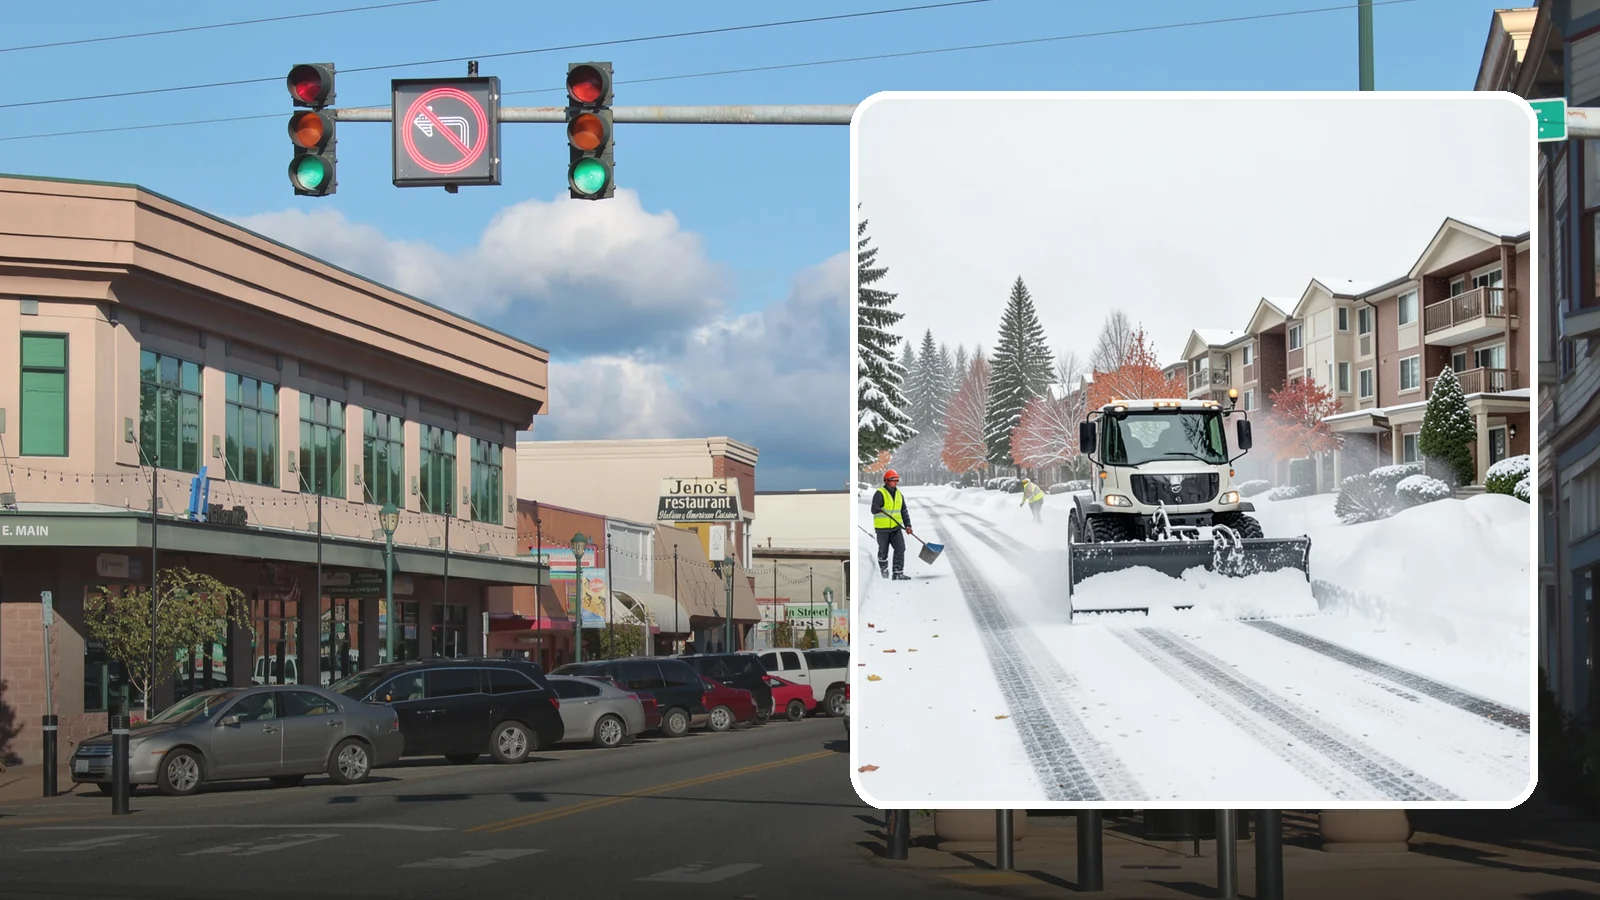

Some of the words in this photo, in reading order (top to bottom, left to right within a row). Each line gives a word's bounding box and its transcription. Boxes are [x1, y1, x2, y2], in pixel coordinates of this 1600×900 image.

[670, 480, 728, 495] Jeno's
[665, 496, 731, 509] restaurant
[715, 509, 737, 519] Cuisine
[2, 525, 13, 536] E.
[15, 525, 49, 536] MAIN
[797, 607, 829, 617] Street
[791, 619, 824, 627] lass
